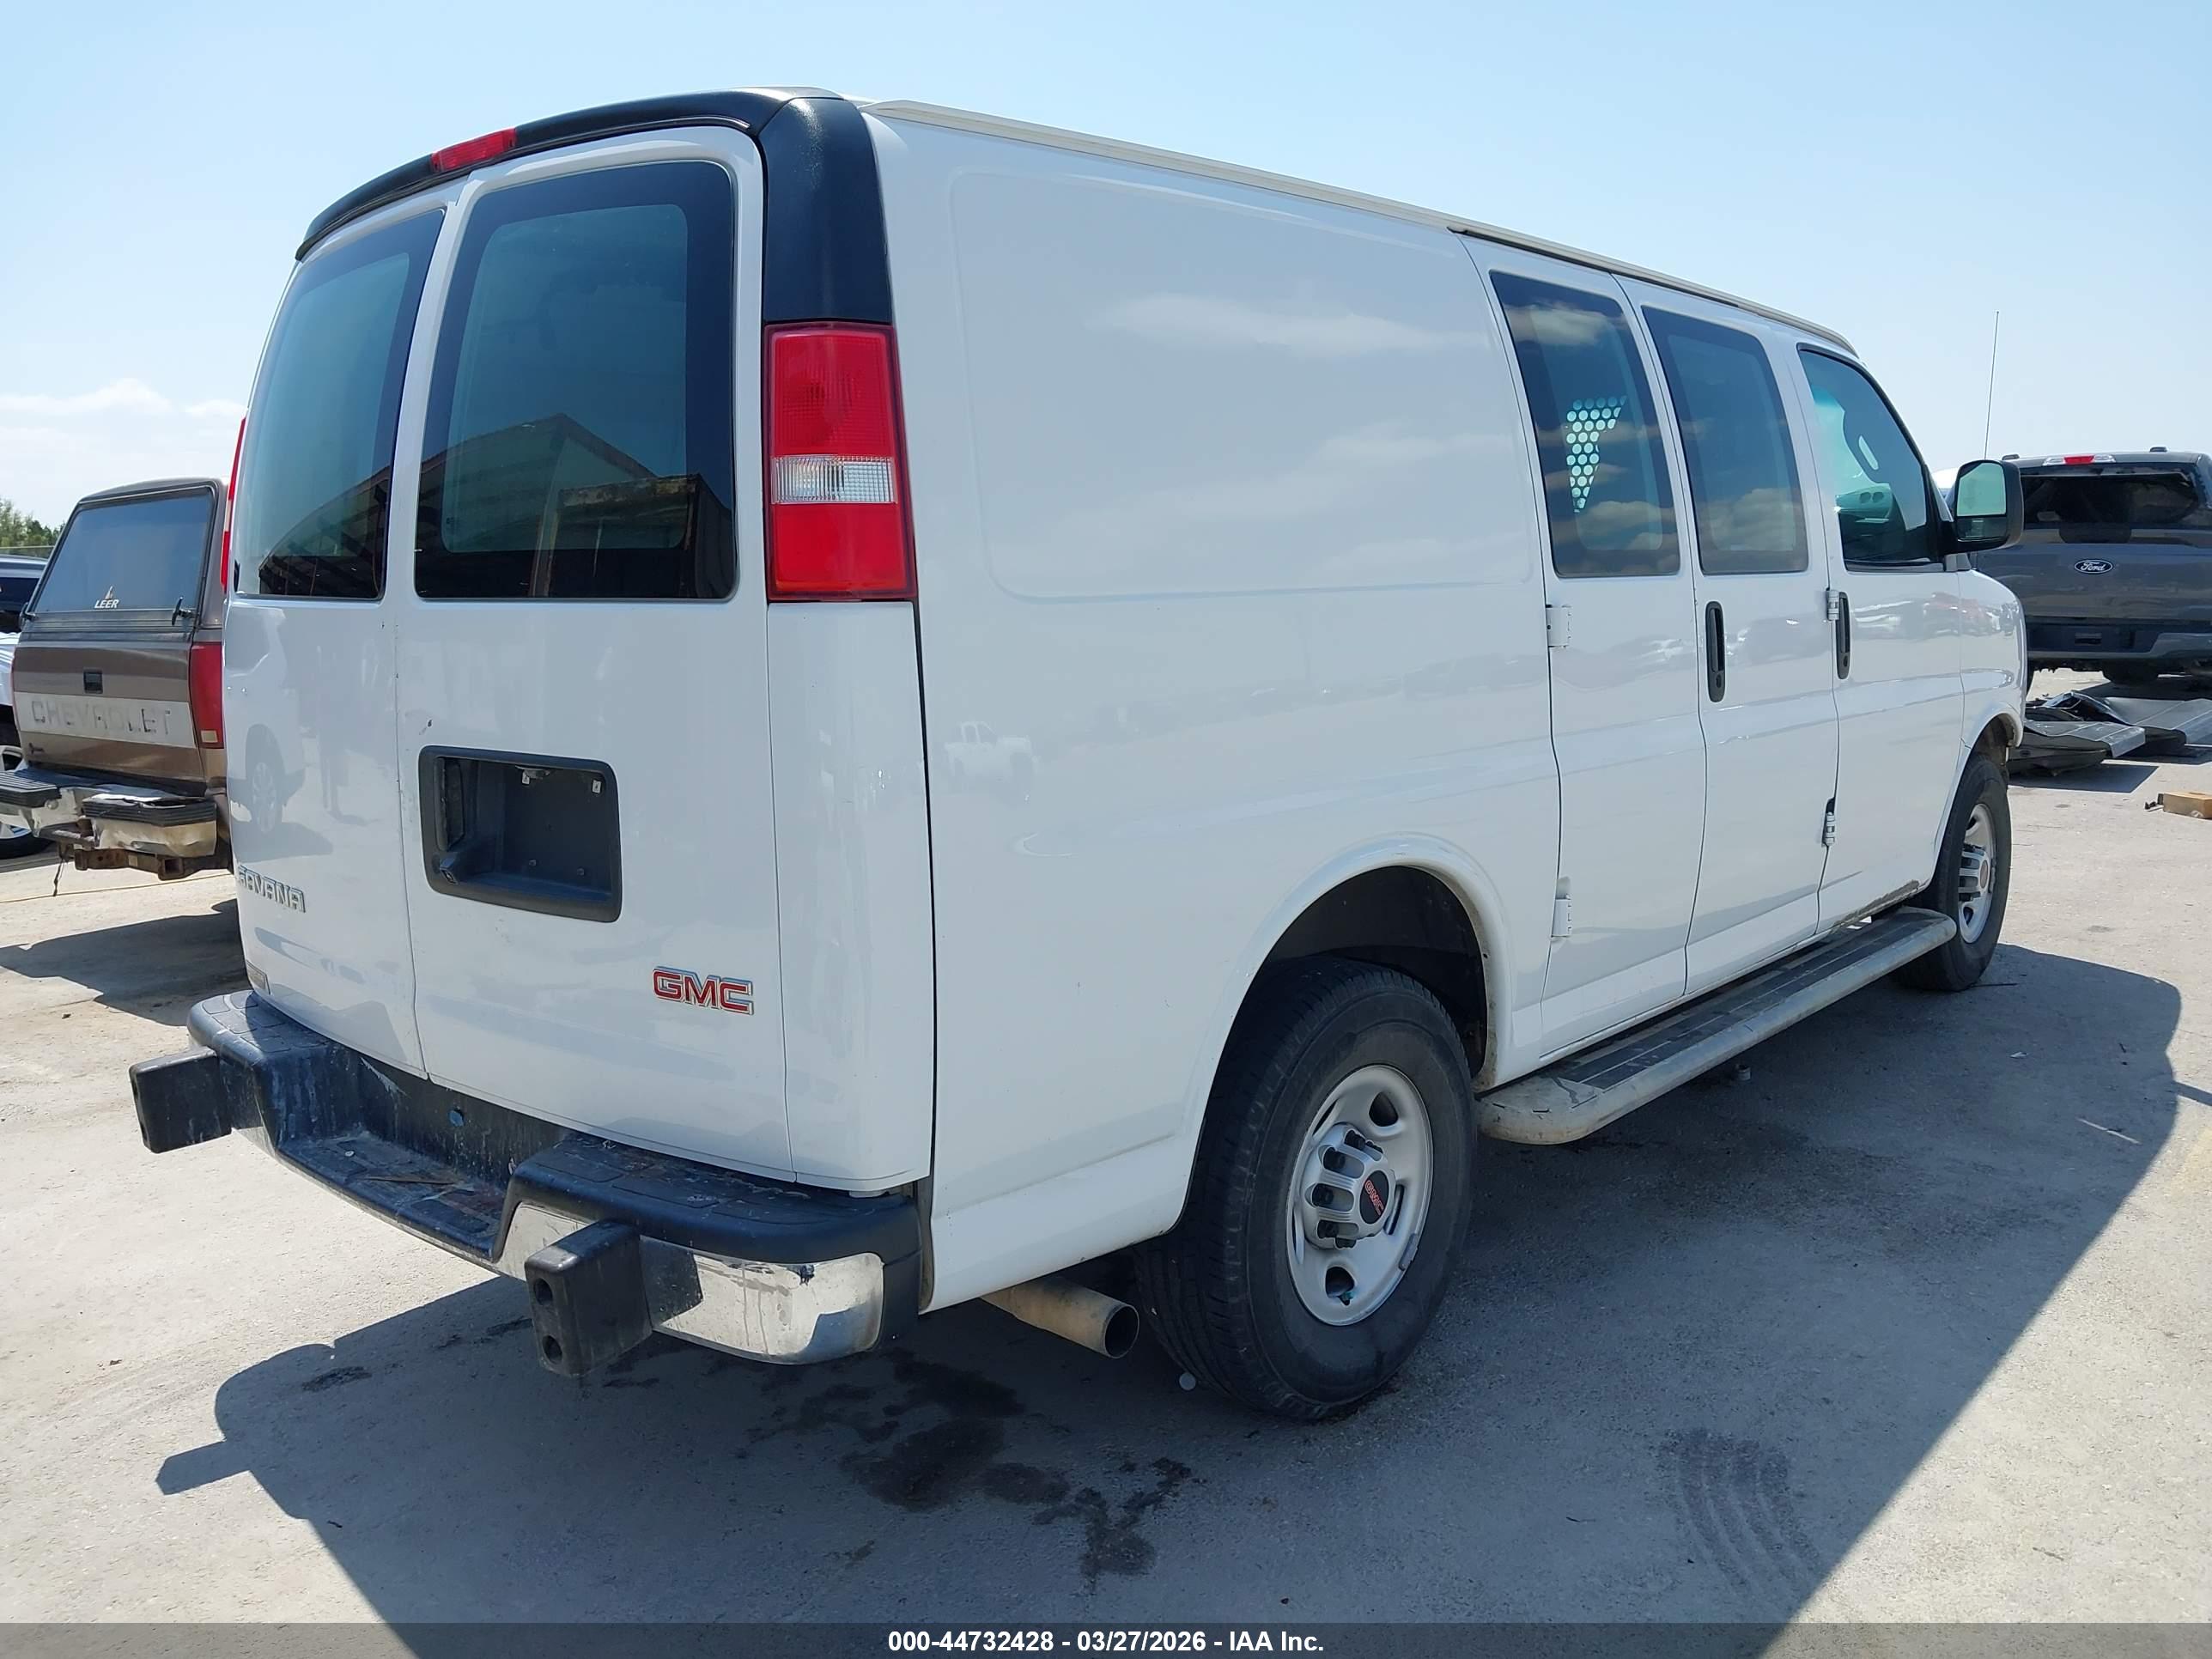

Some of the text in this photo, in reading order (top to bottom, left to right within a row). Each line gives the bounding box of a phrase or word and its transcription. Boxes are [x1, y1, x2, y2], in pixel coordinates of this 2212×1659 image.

[2081, 561, 2106, 571] Ford
[94, 599, 119, 609] LEER
[653, 965, 754, 1015] GMC
[1364, 1179, 1384, 1216] GMC
